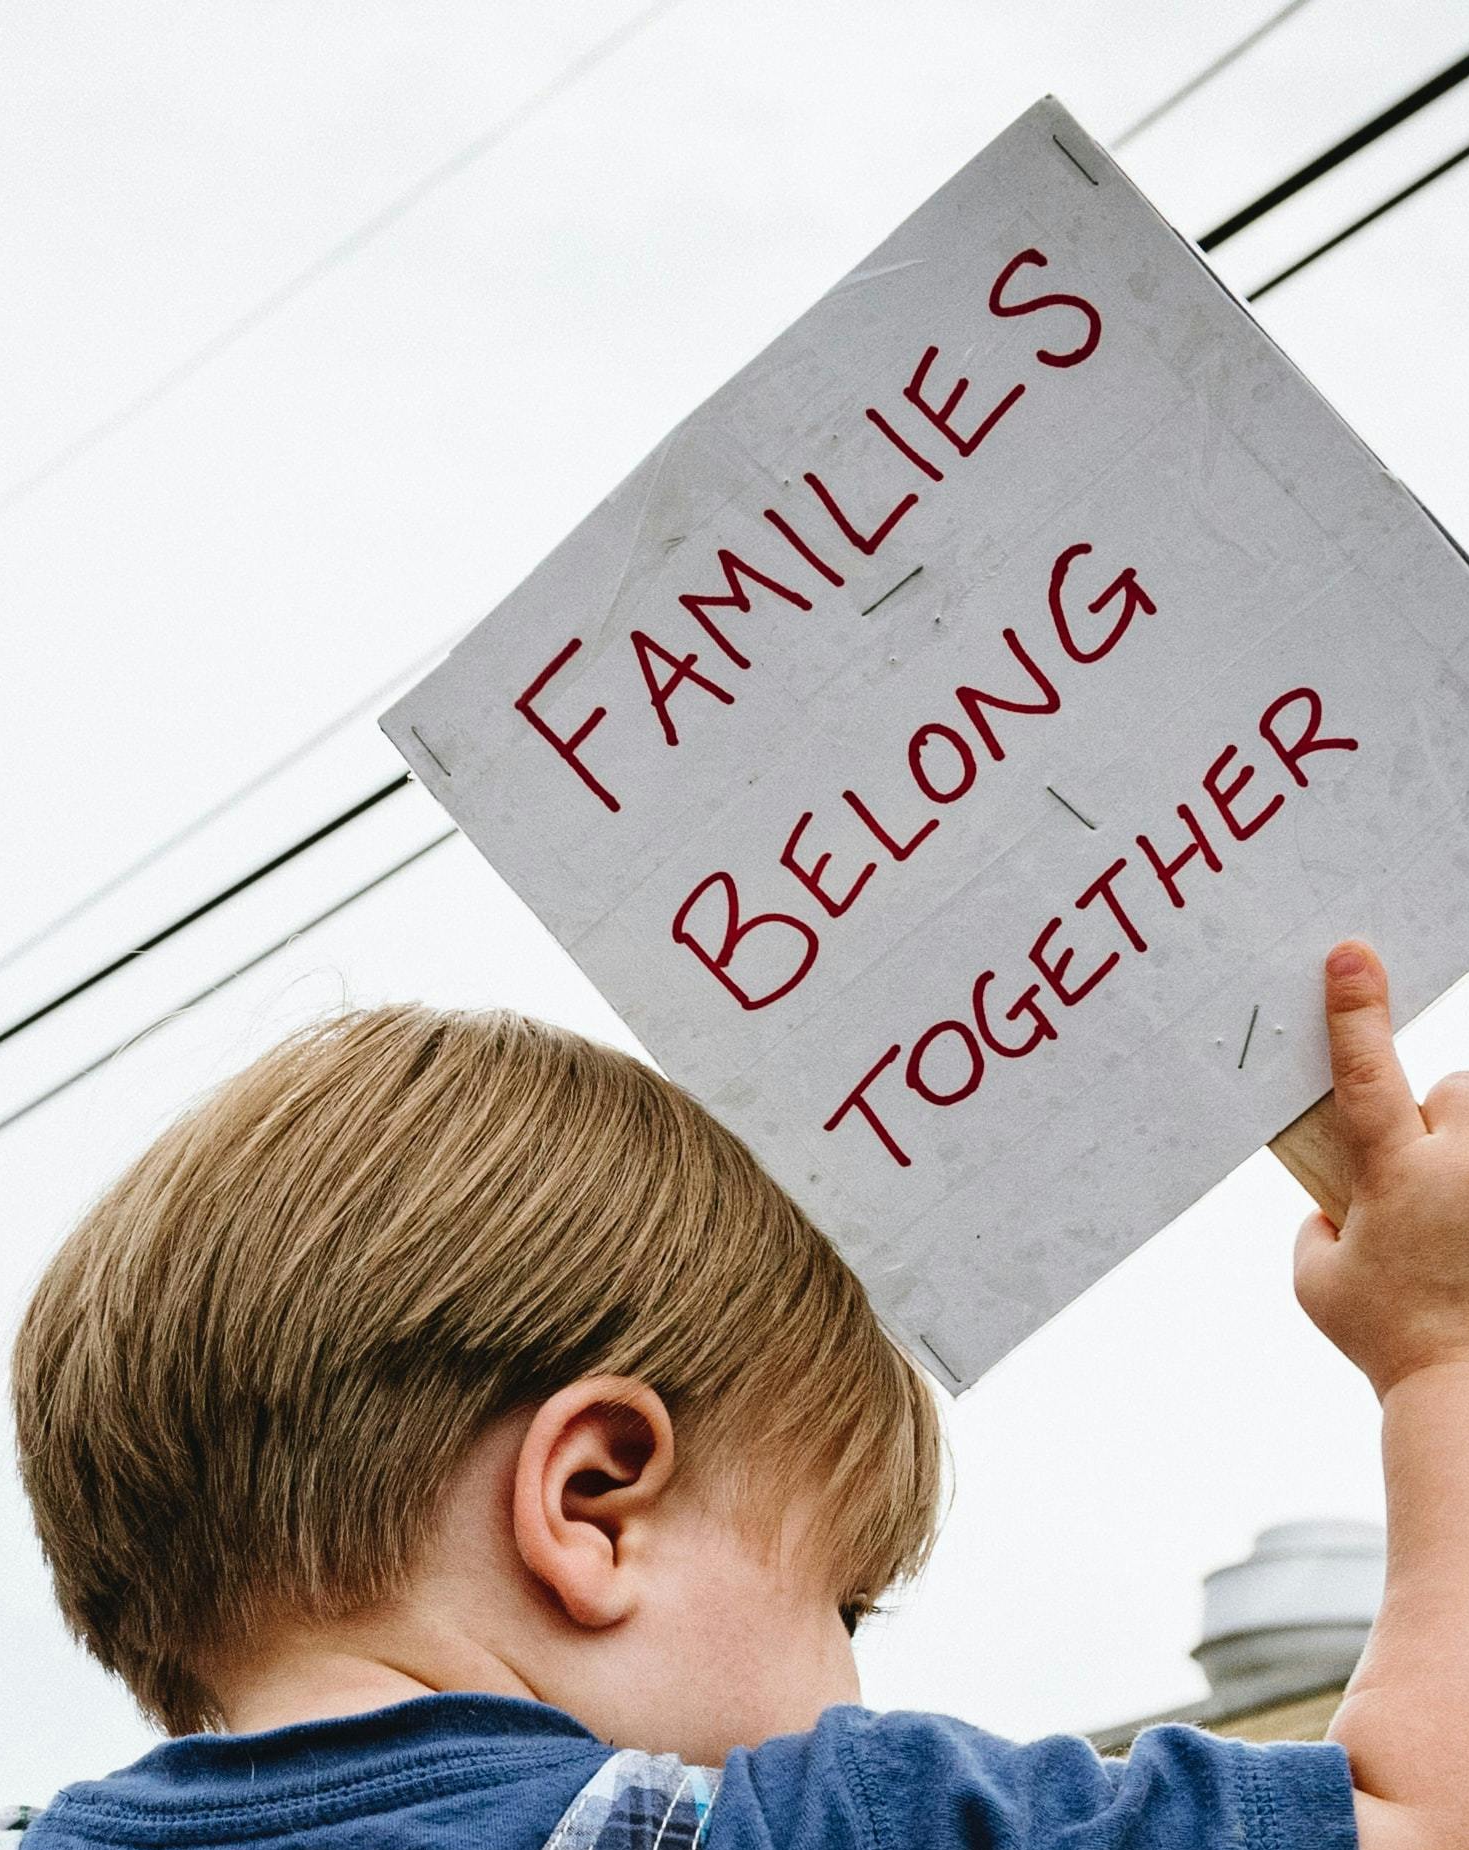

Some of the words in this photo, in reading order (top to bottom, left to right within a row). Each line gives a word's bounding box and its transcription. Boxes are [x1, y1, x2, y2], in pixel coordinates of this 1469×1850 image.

[514, 248, 1102, 811] FAMILIES
[671, 541, 1157, 1010] BELONG
[823, 685, 1359, 1166] TOGETHER
